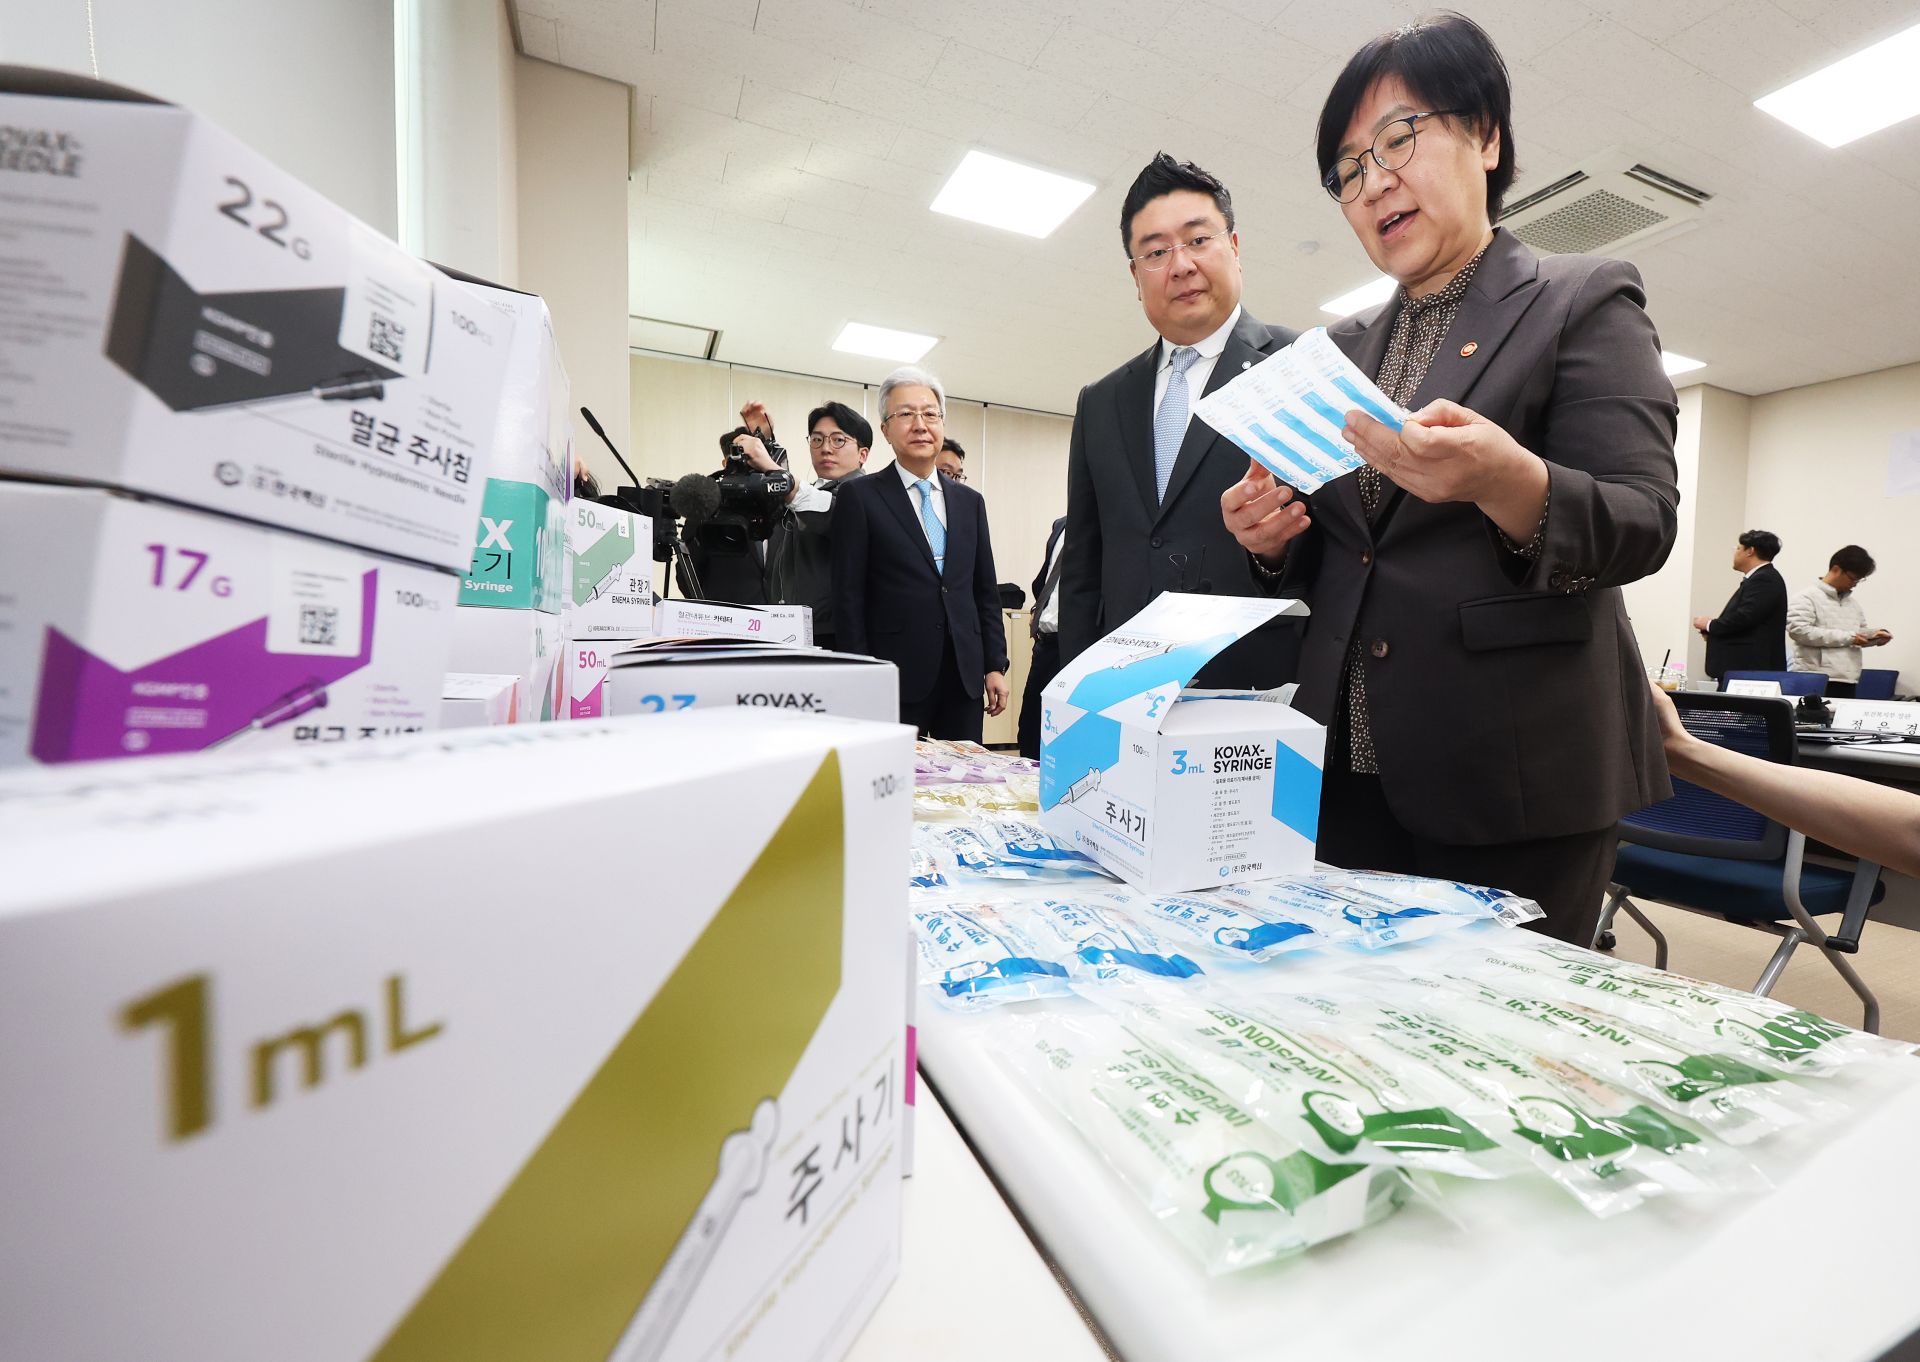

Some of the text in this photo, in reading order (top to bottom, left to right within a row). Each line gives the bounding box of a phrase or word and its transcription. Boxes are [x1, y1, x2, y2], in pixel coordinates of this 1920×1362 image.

[350, 409, 402, 456] 멸균
[407, 434, 472, 485] 주사침
[767, 481, 788, 493] KBS
[578, 508, 606, 532] 50mL
[145, 543, 234, 599] 17G
[464, 579, 514, 594] Syringe
[629, 577, 651, 594] 관장기
[611, 595, 651, 606] ENEMA SYRINGE
[747, 619, 761, 632] 20
[578, 650, 607, 669] 50mL
[736, 693, 822, 708] KOVAX-
[1144, 691, 1166, 718] 3mL
[1044, 709, 1058, 735] 3mL
[1214, 744, 1265, 760] KOVAX-
[1170, 750, 1205, 776] 3mL
[1213, 757, 1272, 774] SYRINGE
[1105, 800, 1146, 842] 주사기
[1231, 862, 1262, 874] (주)한국백신
[1557, 963, 1601, 975] SET
[112, 968, 446, 1147] 1mL
[1153, 1070, 1254, 1129] INFUSION
[785, 1058, 894, 1225] 주사기
